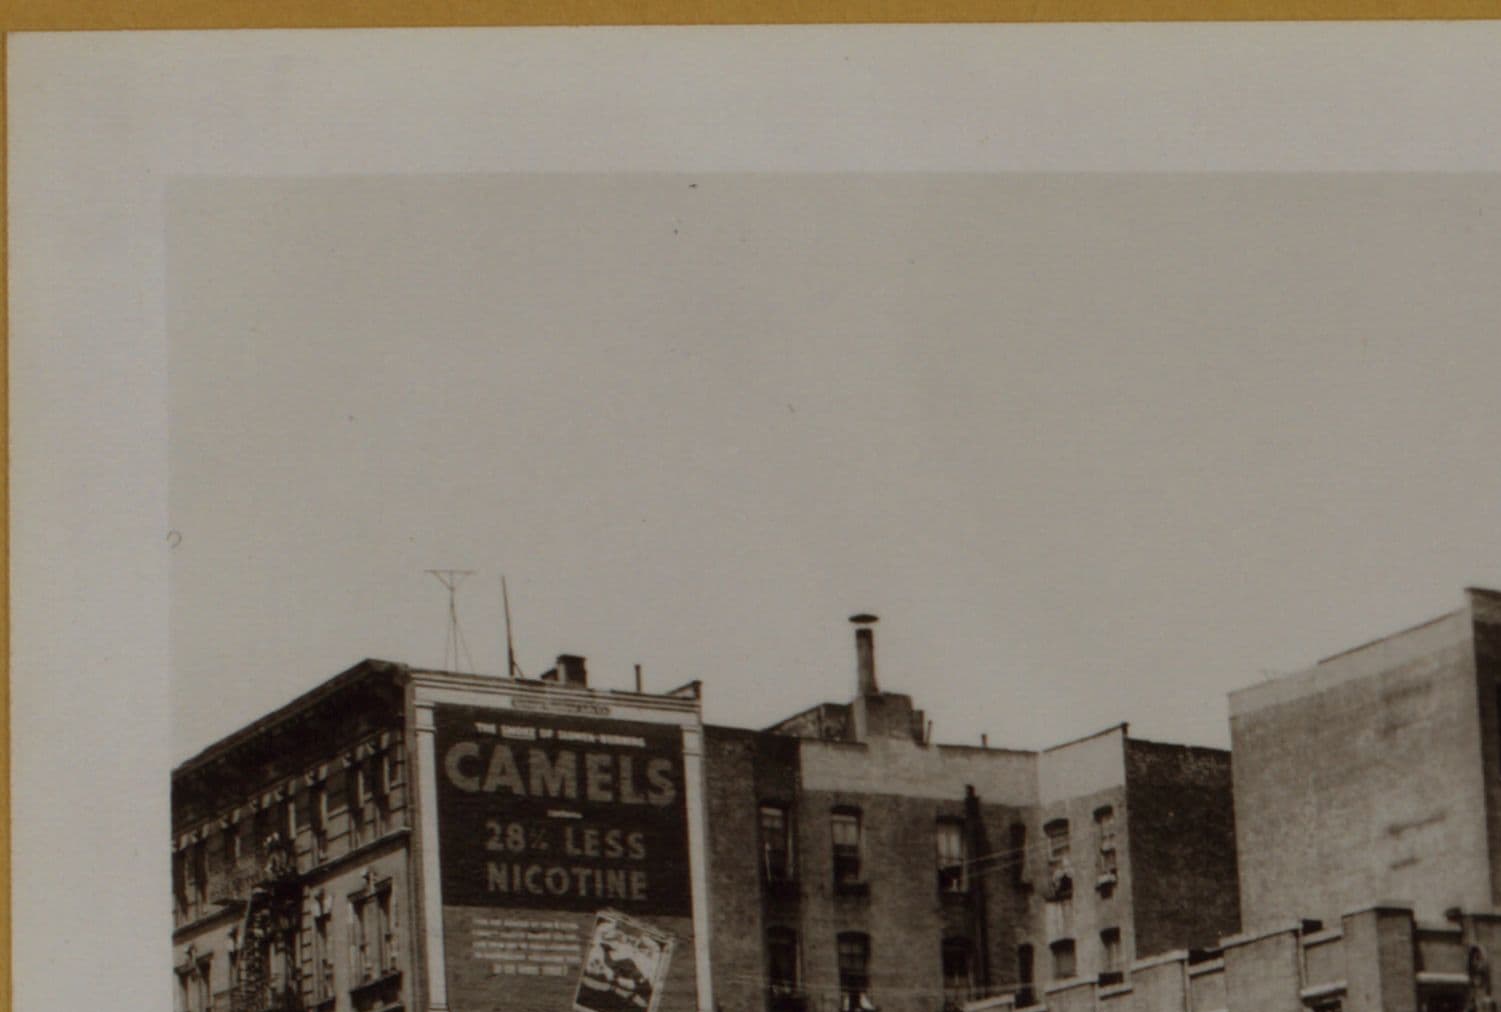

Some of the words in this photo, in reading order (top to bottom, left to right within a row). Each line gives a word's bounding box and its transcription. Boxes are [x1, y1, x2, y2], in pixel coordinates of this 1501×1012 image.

[444, 742, 677, 806] CAMELS
[564, 826, 647, 860] LESS
[486, 861, 648, 901] NICOTINE
